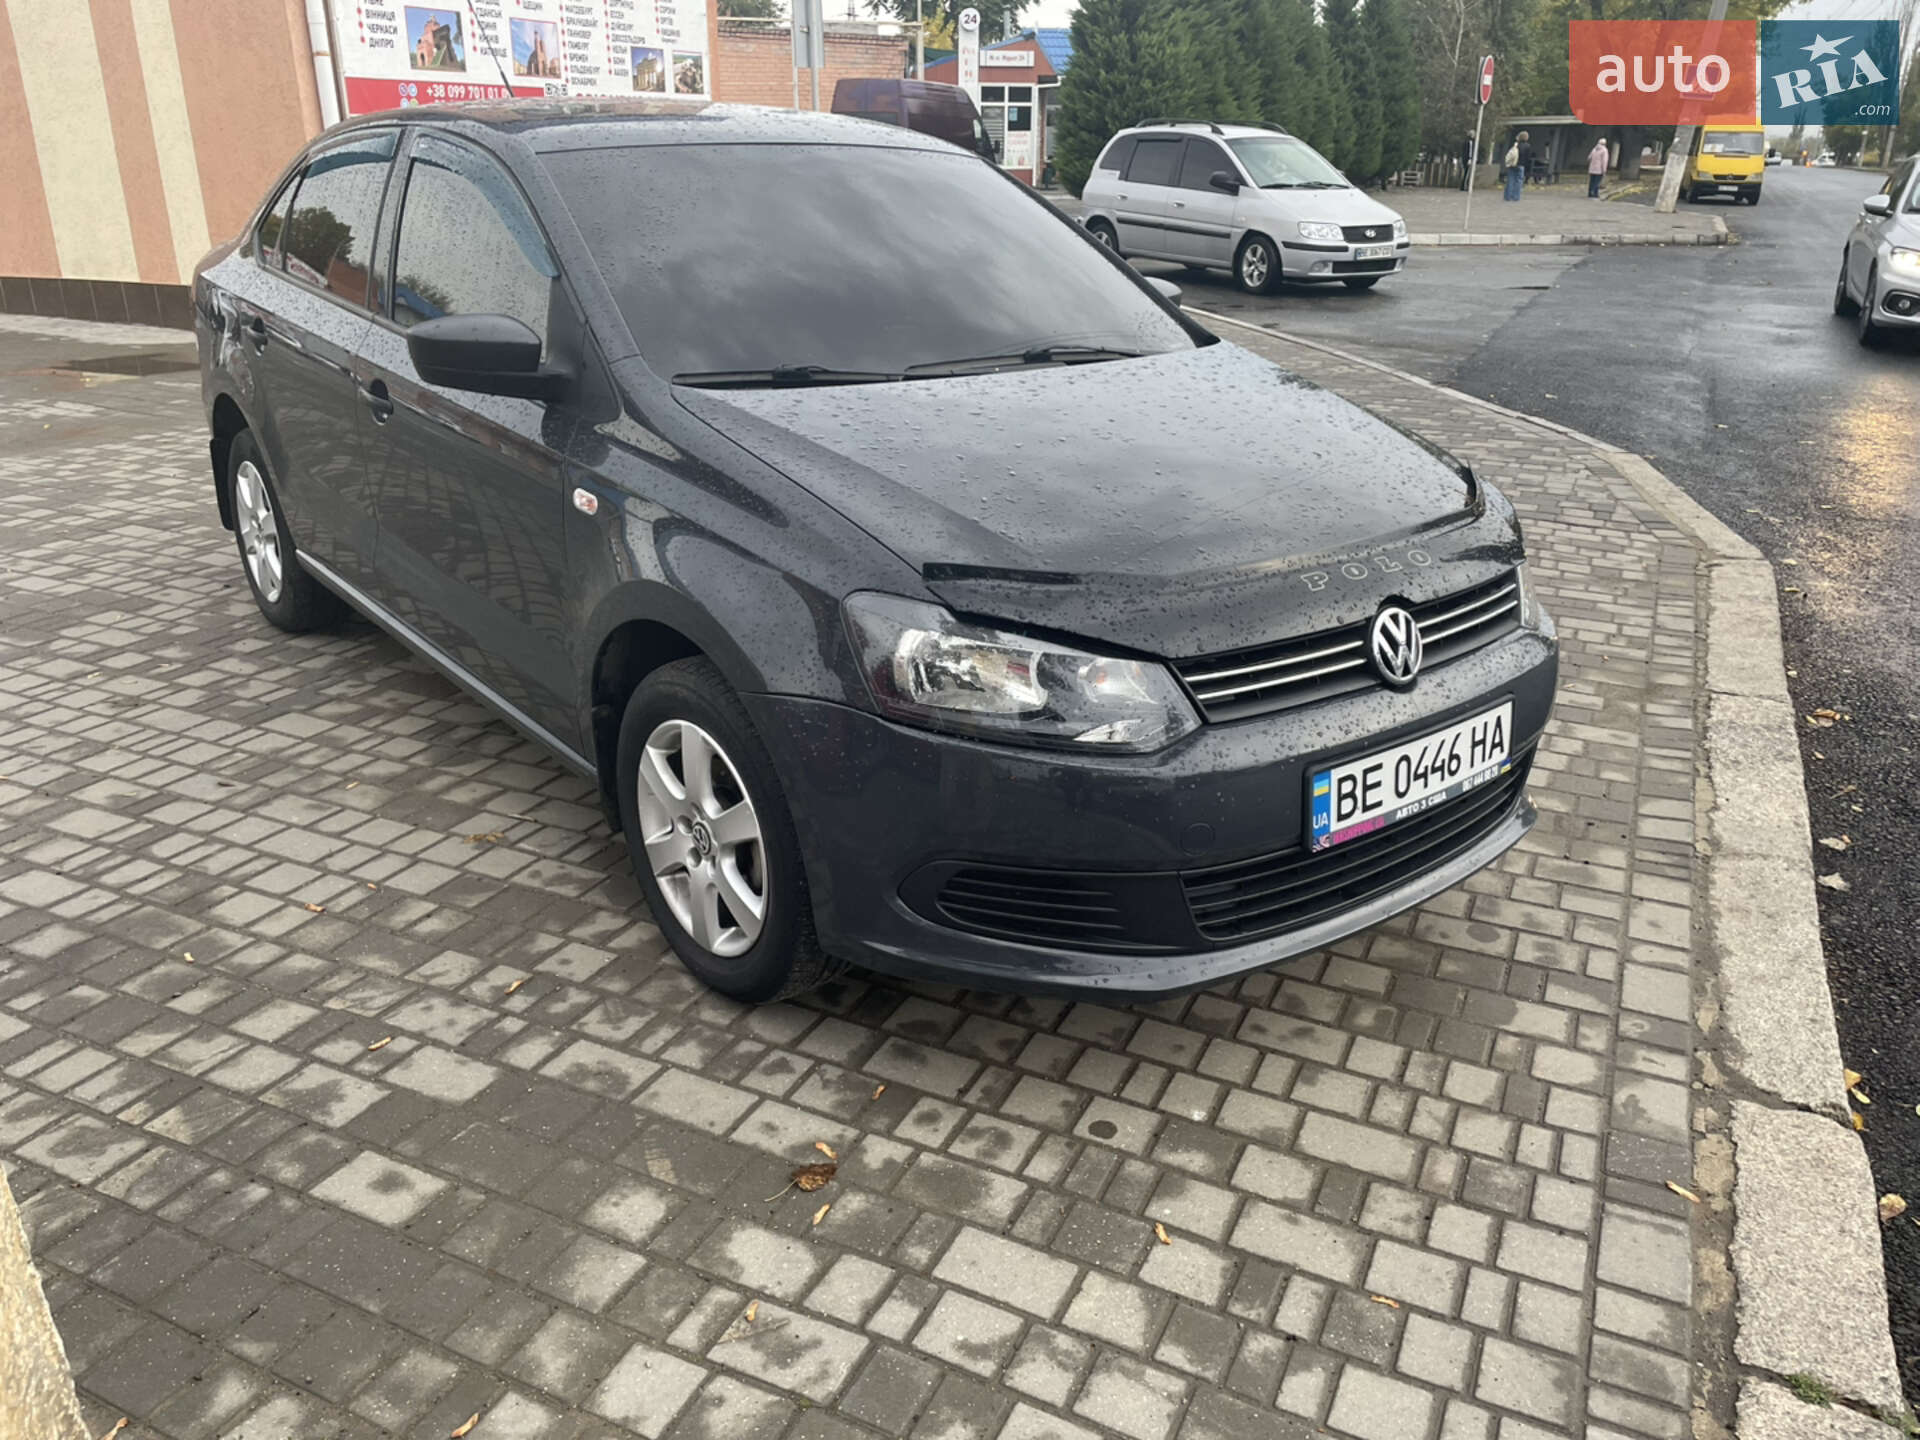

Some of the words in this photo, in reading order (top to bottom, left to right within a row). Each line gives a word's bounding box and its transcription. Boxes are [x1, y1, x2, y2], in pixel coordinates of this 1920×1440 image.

[964, 13, 977, 24] 24
[426, 84, 446, 97] +38
[447, 85, 465, 98] 099
[467, 86, 485, 99] 701
[1300, 550, 1432, 591] POLO
[1336, 762, 1384, 823] BE
[1394, 732, 1461, 799] 0446
[1469, 715, 1505, 769] HA
[1312, 811, 1329, 829] UA
